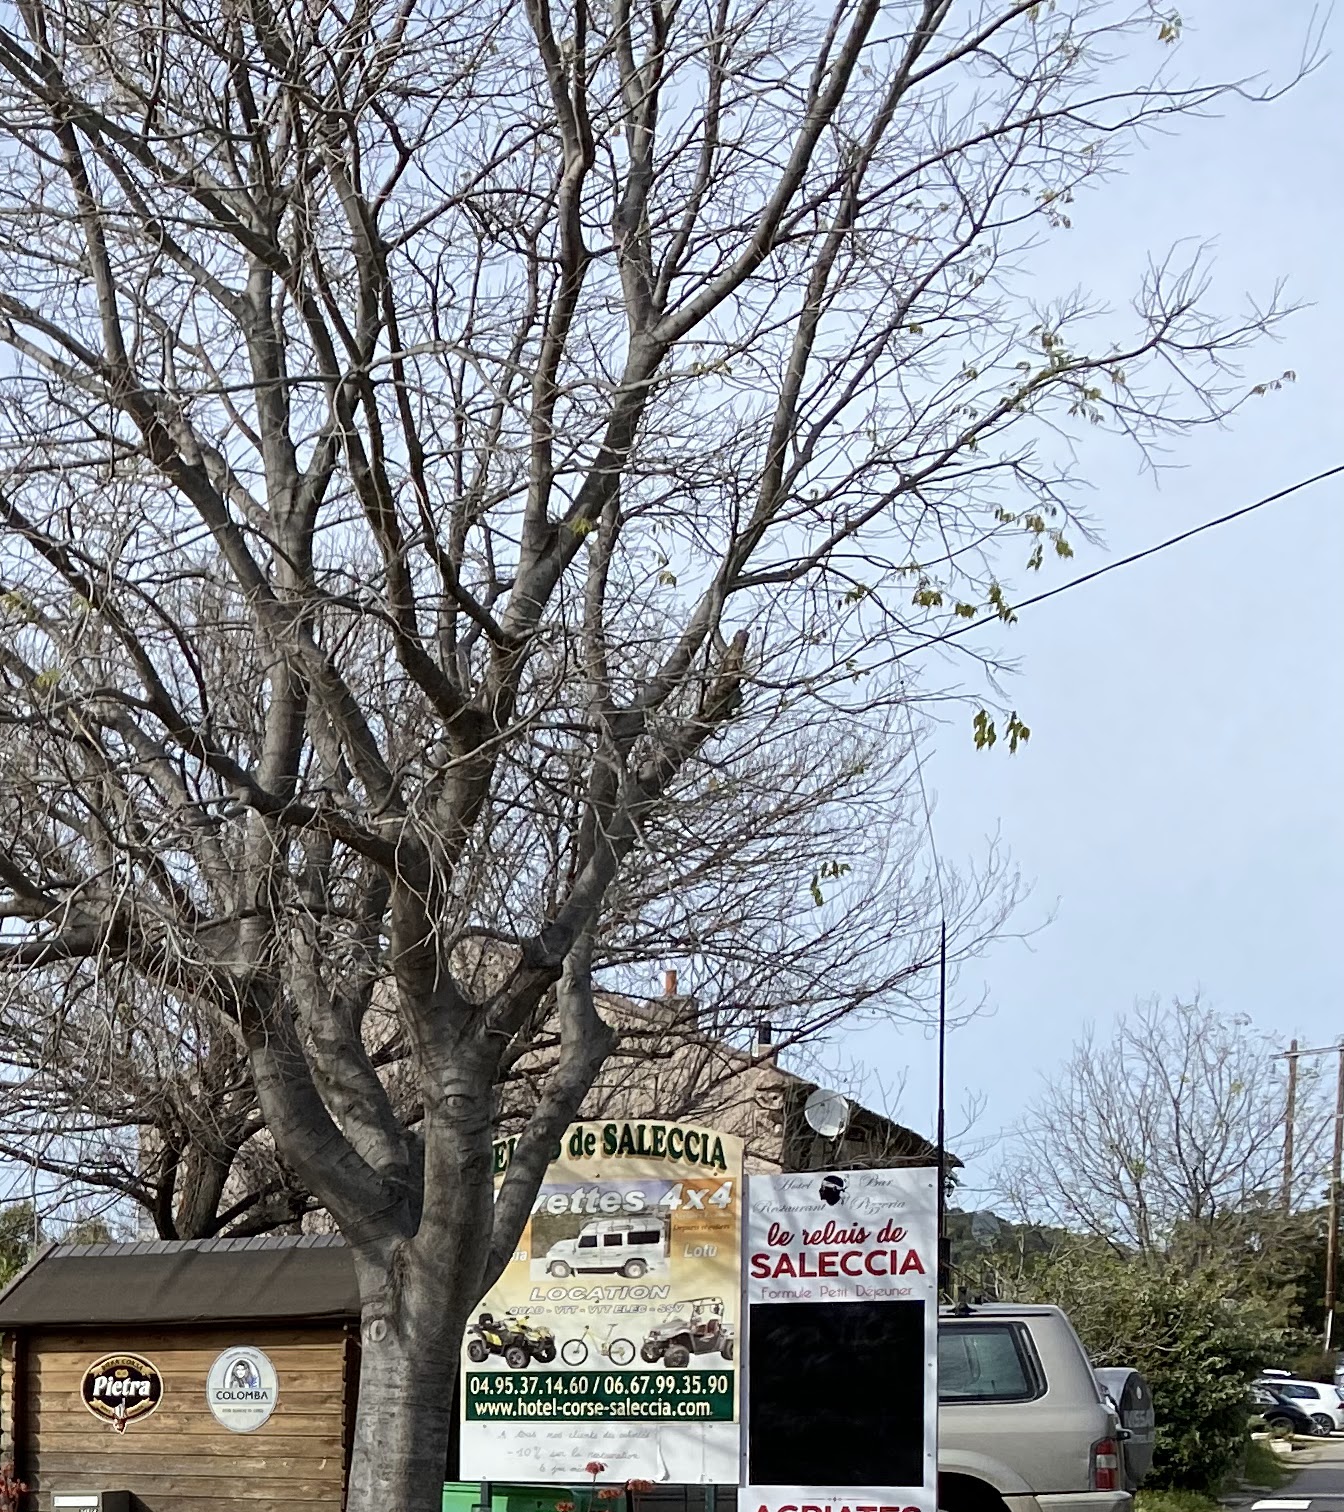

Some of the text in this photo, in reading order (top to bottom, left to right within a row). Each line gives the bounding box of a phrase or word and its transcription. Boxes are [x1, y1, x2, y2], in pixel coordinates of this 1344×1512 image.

[569, 1126, 596, 1157] de
[602, 1123, 728, 1170] SALECCIA
[659, 1181, 733, 1210] 4x4
[752, 1197, 906, 1214] Restaurant Pizzeria
[767, 1218, 908, 1247] le relais de
[750, 1249, 926, 1279] SALECCIA
[530, 1285, 670, 1301] LOCATION
[761, 1284, 913, 1299] Formule Petit Déjeuner
[93, 1375, 151, 1397] Pietra
[470, 1376, 589, 1395] 04.95.37.14.60
[604, 1375, 728, 1395] 06.67.99.35.90
[216, 1391, 268, 1400] COLOMBA
[475, 1398, 711, 1416] www.hotel-corse-saleccia.com
